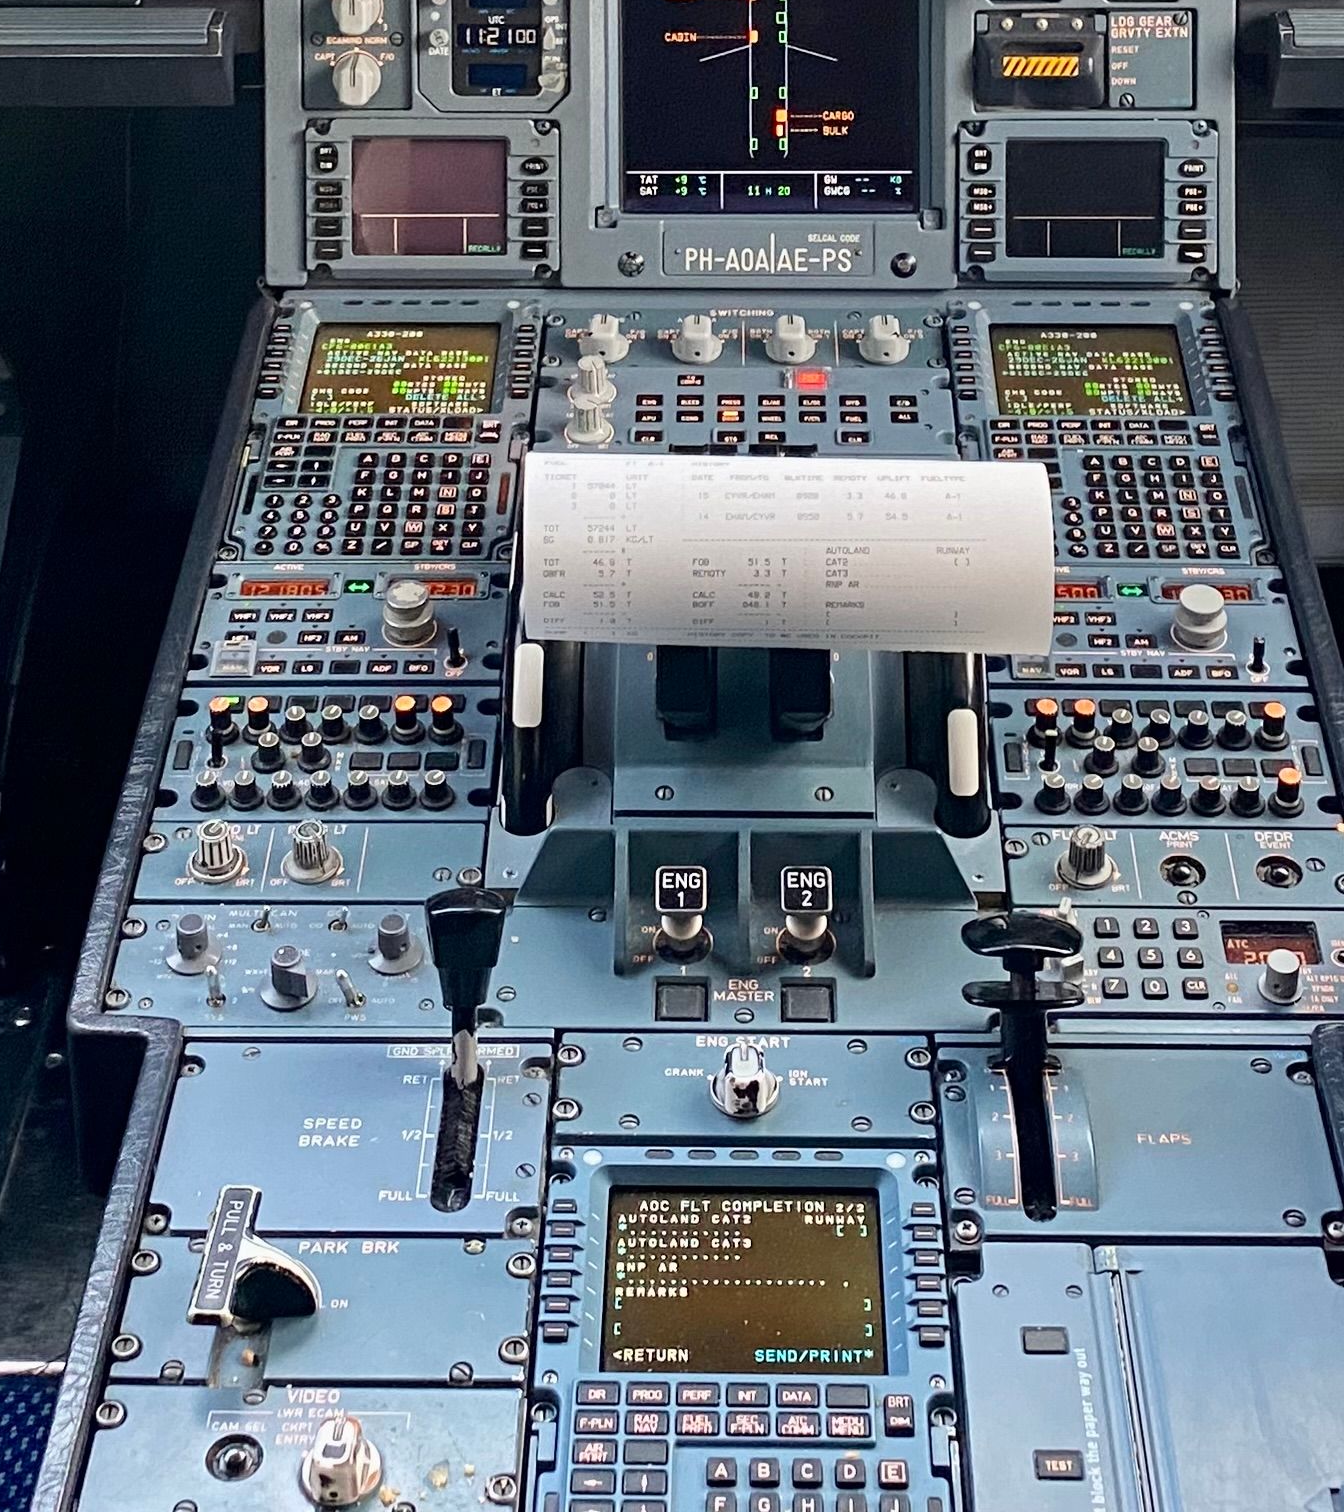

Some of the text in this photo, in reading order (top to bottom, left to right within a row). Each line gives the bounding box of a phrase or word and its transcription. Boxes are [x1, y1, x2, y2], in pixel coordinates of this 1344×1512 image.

[1110, 17, 1172, 27] LDG GEAR
[1110, 27, 1189, 38] GRVTY EXTN
[428, 47, 449, 56] DATE
[822, 111, 854, 121] CARGO
[823, 126, 848, 135] BULK
[776, 248, 852, 272] AE-PS
[825, 547, 870, 555] AUTOLAND
[825, 558, 849, 566] CAT2
[1159, 831, 1199, 841] ACMS
[1254, 831, 1294, 842] DFDR
[662, 872, 701, 889] ENG
[787, 872, 825, 888] ENG
[678, 891, 685, 908] 1
[801, 891, 812, 907] 2
[728, 979, 759, 990] ENG
[713, 991, 775, 1002] MASTER
[696, 1036, 728, 1047] ENG
[665, 1068, 704, 1077] CRANK
[789, 1077, 828, 1086] START
[302, 1117, 363, 1130] SPEED
[298, 1134, 361, 1147] BRAKE
[1137, 1133, 1192, 1146] FLAPS
[378, 1191, 413, 1202] FULL
[639, 1200, 825, 1214] AOC FLT COMPLETION
[223, 1200, 245, 1236] PULL
[618, 1215, 752, 1224] AUTOLAND CAT2
[805, 1215, 865, 1225] RUNWAY
[298, 1241, 400, 1254] PARK BRK
[618, 1238, 752, 1249] AUTOLAND CAT3
[616, 1262, 678, 1272] RNP AR
[206, 1259, 230, 1300] TURN
[615, 1287, 688, 1297] REMARKS
[330, 1298, 348, 1309] ON
[613, 1348, 689, 1362] <RETURN
[287, 1389, 340, 1404] VIDEO
[588, 1390, 606, 1400] DIR
[888, 1396, 909, 1408] BRT
[1074, 1348, 1104, 1503] block the paper way out
[1045, 1460, 1073, 1471] TEST
